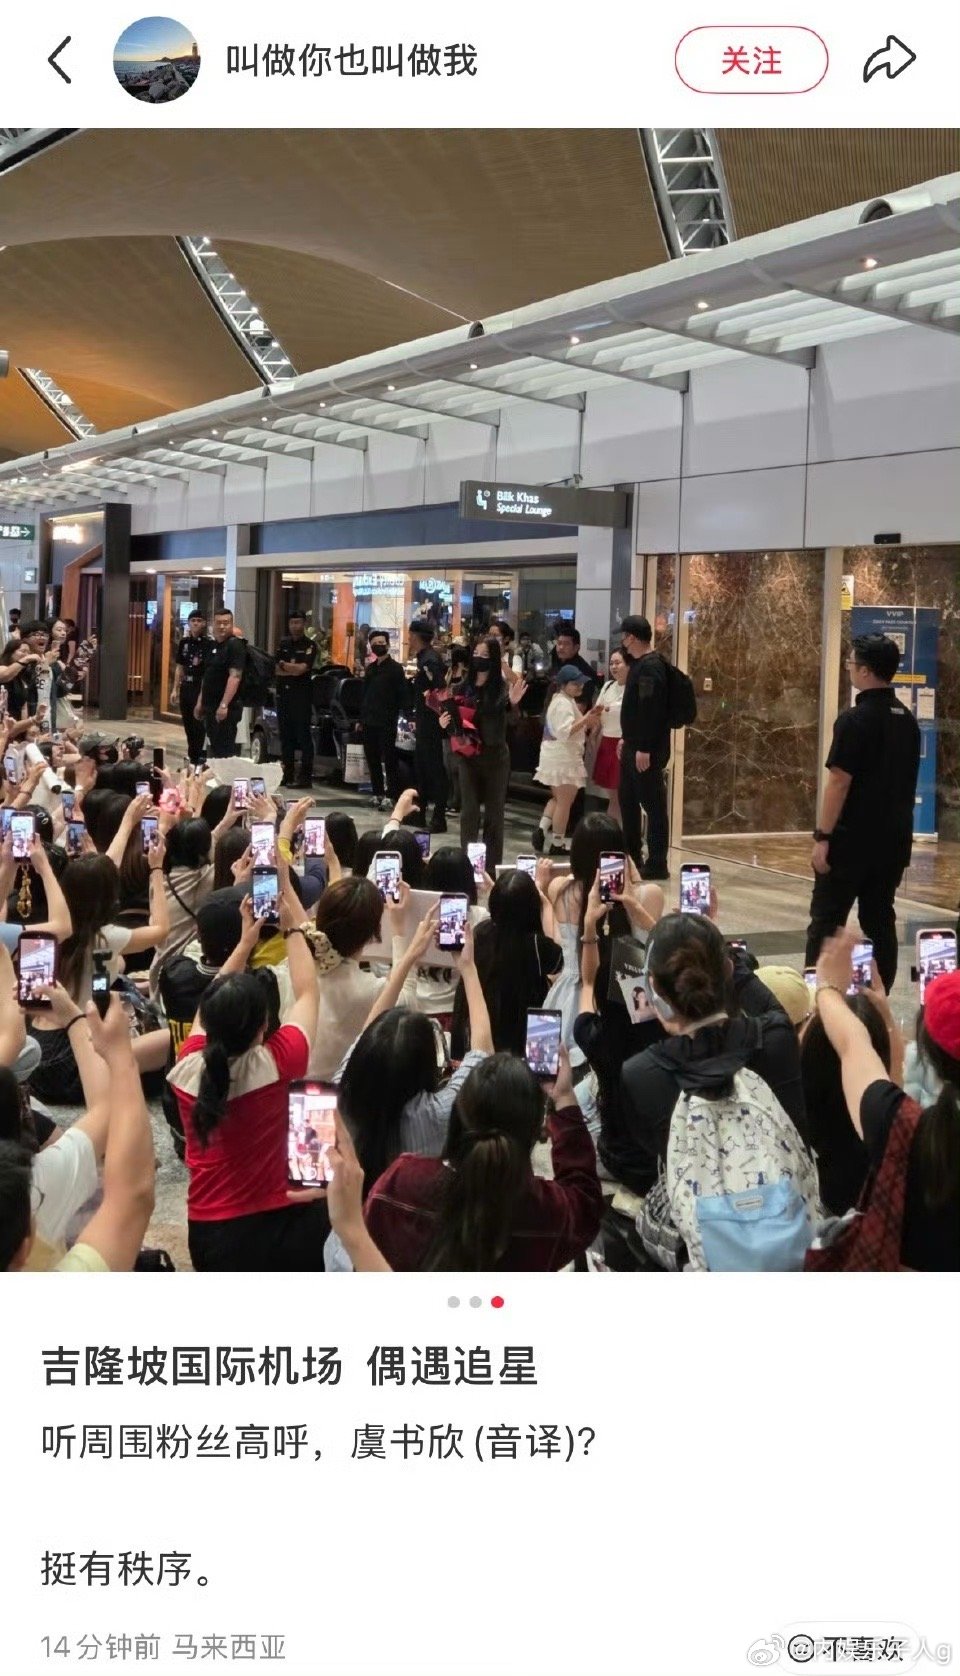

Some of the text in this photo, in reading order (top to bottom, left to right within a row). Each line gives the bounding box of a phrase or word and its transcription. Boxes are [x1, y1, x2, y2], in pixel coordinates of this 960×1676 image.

[516, 491, 540, 504] Khas
[496, 502, 553, 518] Special Lounge
